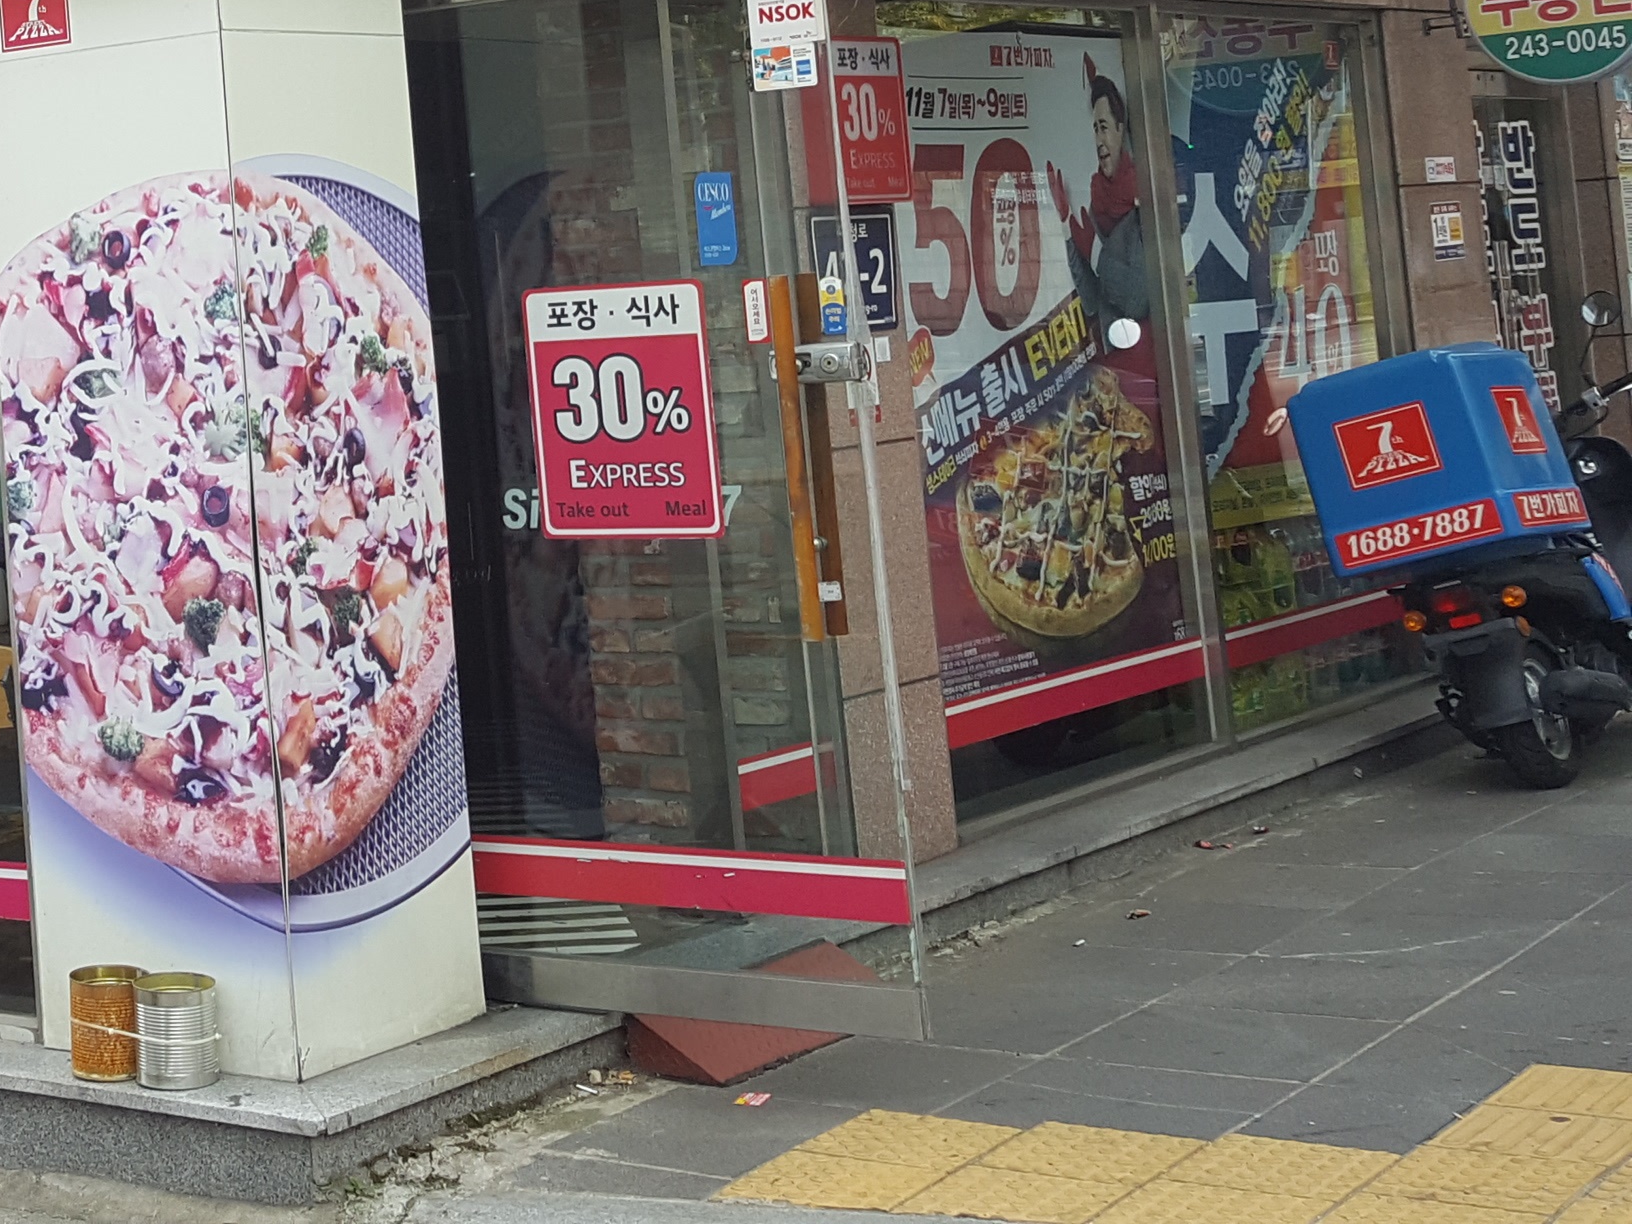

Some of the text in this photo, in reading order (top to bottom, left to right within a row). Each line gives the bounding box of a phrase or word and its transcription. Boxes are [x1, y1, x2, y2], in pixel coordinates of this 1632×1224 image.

[758, 1, 815, 24] NSOK
[9, 23, 61, 42] PIZZA
[1506, 25, 1627, 60] 243-0045
[837, 48, 858, 70] 포장
[868, 48, 890, 70] 식사
[841, 82, 895, 141] 30%
[697, 183, 729, 202] CESCO
[909, 138, 1042, 337] 50
[825, 248, 887, 294] 4-2
[546, 294, 680, 330] 포장 식사
[909, 338, 932, 375] NEW
[551, 353, 692, 444] 30%
[921, 389, 981, 466] 신메뉴
[980, 346, 1028, 418] 출시
[1024, 296, 1087, 381] EVENT
[1358, 454, 1427, 478] PIZZA
[556, 500, 707, 518] Take out Meal
[1519, 493, 1581, 520] 7번가피자
